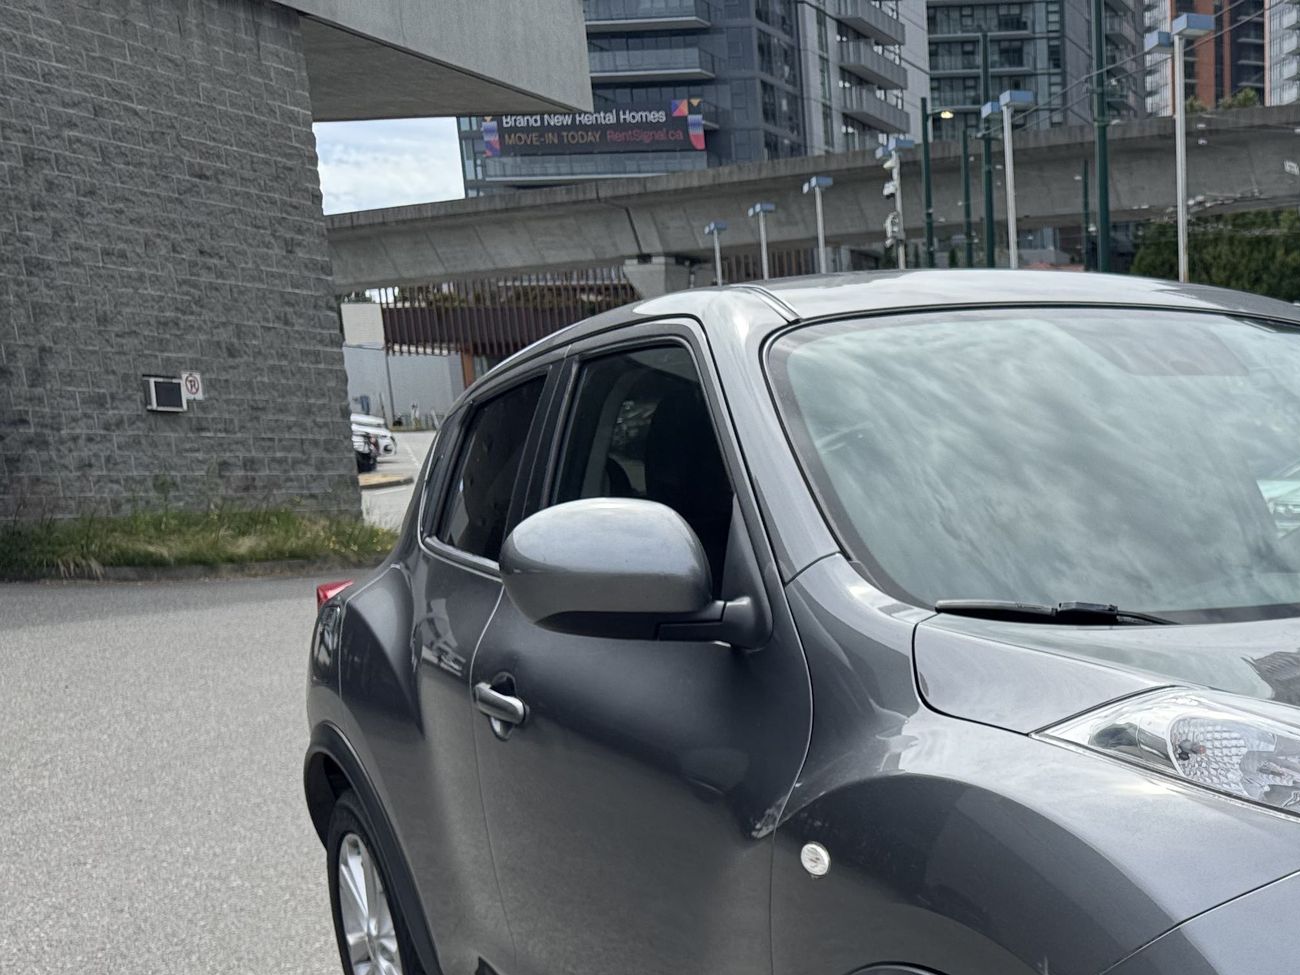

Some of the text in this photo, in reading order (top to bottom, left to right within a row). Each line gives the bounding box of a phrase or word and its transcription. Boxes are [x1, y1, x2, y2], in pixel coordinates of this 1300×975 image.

[502, 109, 666, 127] Brand New Rental Homes
[505, 128, 684, 145] MOVE-IN TODAY RentSignal.ca
